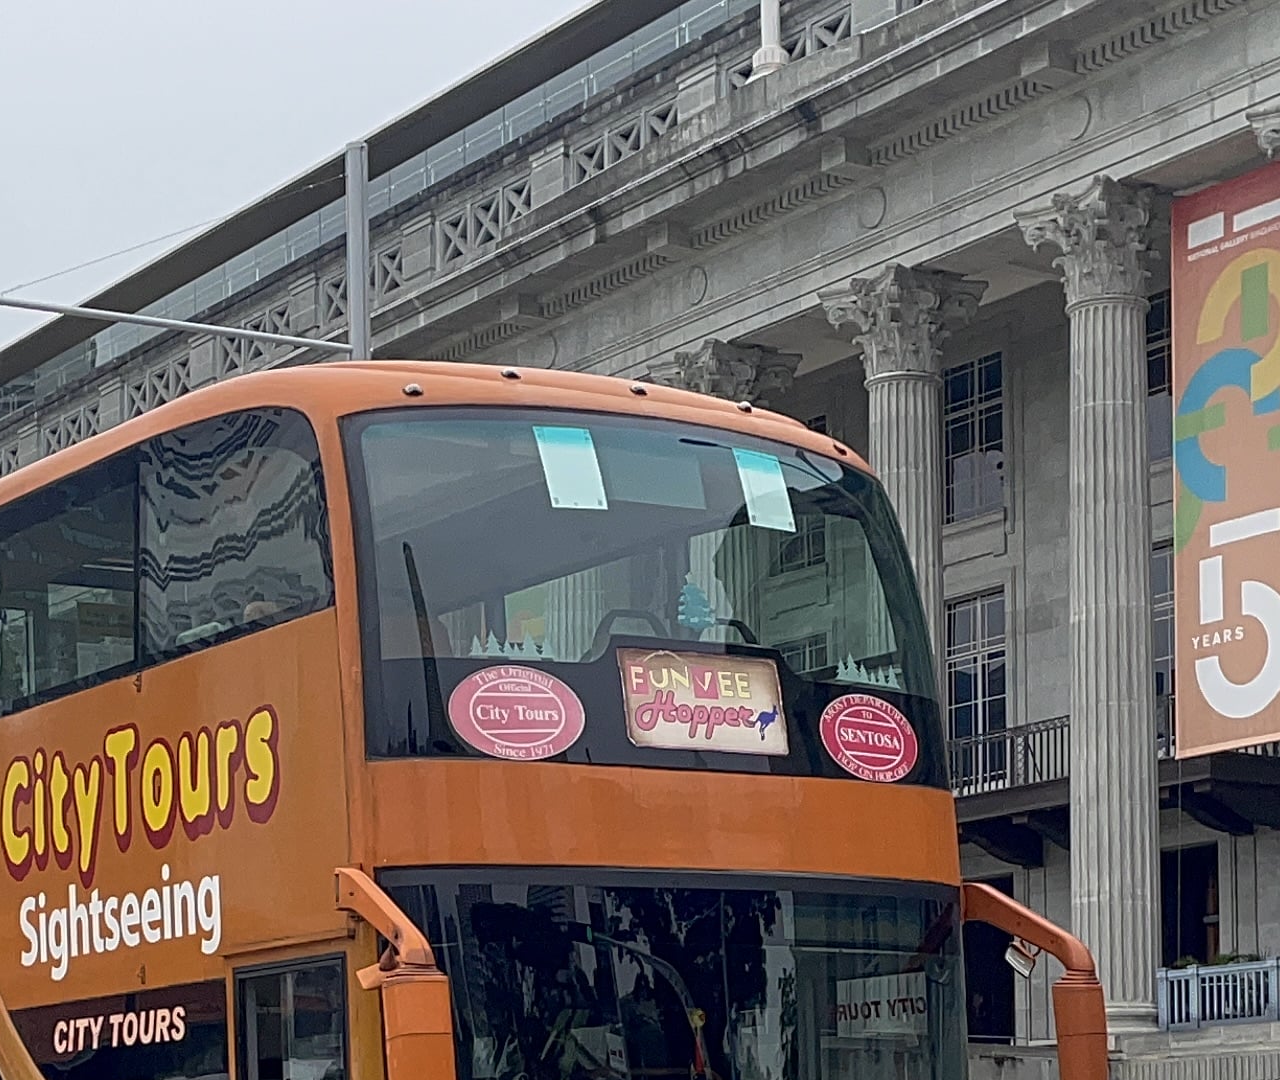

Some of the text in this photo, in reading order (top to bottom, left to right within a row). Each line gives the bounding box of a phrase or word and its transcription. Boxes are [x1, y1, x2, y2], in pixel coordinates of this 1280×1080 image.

[1191, 626, 1245, 650] YEARS
[472, 668, 554, 689] The Original
[628, 664, 752, 699] FUNVEE
[476, 704, 559, 724] City Tours
[635, 690, 756, 739] Hopper
[823, 696, 911, 735] MOST DEPARTURES
[493, 743, 554, 758] Since 1971
[840, 727, 900, 750] SENTOSA
[837, 751, 858, 770] HOP
[859, 767, 873, 780] ON
[19, 863, 222, 981] Sightseeing
[53, 1006, 187, 1054] CITY TOURS
